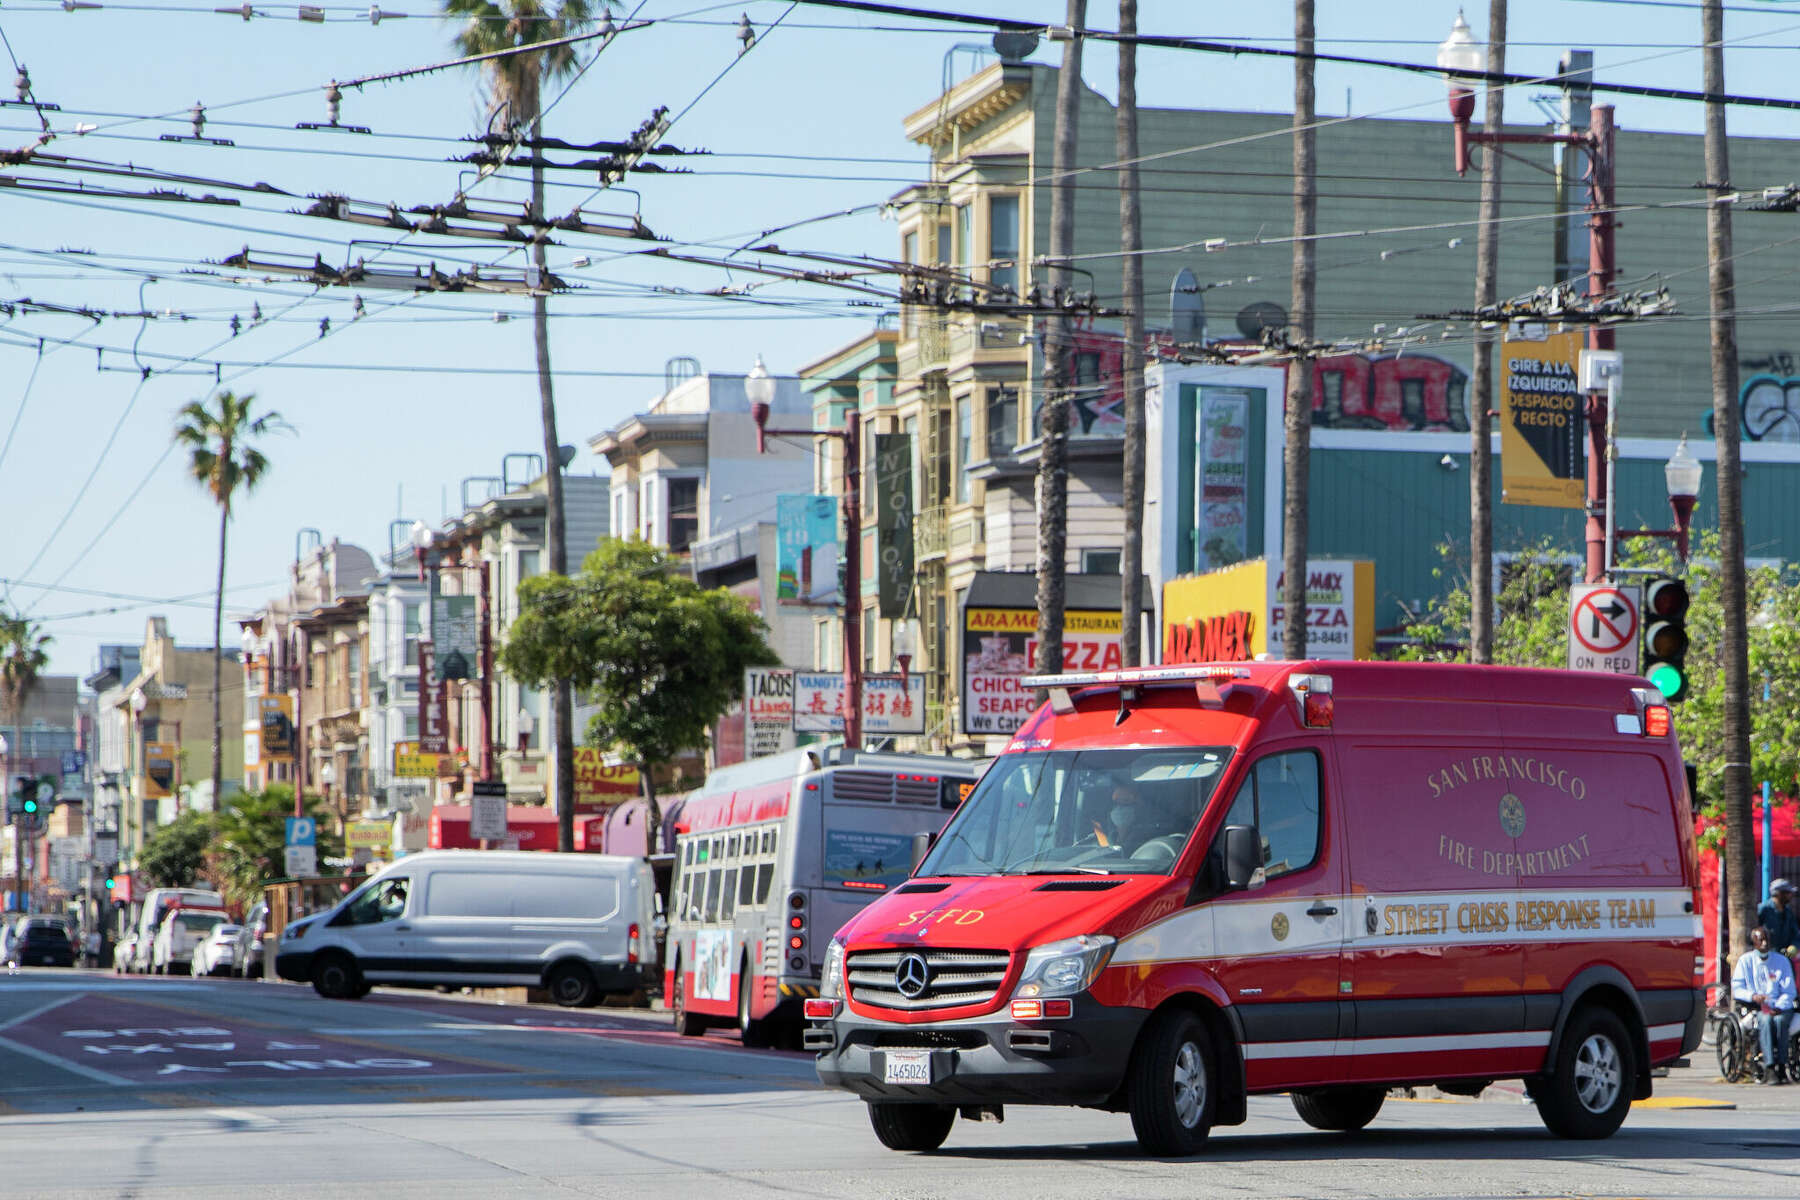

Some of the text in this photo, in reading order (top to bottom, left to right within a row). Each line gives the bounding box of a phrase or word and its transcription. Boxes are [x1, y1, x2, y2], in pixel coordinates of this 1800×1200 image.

[1508, 358, 1571, 375] GIRE A LA
[1507, 376, 1577, 393] IZQUIERDA
[1508, 393, 1574, 410] DESPACIO
[1520, 414, 1566, 427] RECTO
[1276, 572, 1344, 590] AMEX
[971, 612, 1040, 628] ARAME
[1272, 608, 1348, 626] PZZA
[1163, 611, 1251, 664] ARAMEX
[1028, 642, 1121, 670] PZZA
[1576, 657, 1631, 670] ON RED
[750, 674, 792, 697] TACOS
[972, 677, 1035, 694] CHICK
[972, 715, 992, 729] We
[1428, 756, 1585, 800] SAN FRANCISCO
[1439, 834, 1590, 876] FIRE DEPARTMENT
[898, 909, 984, 926] SFFD
[1384, 898, 1656, 935] STREET CRISIS RESPONSE TEAM
[888, 1063, 927, 1079] 1465026
